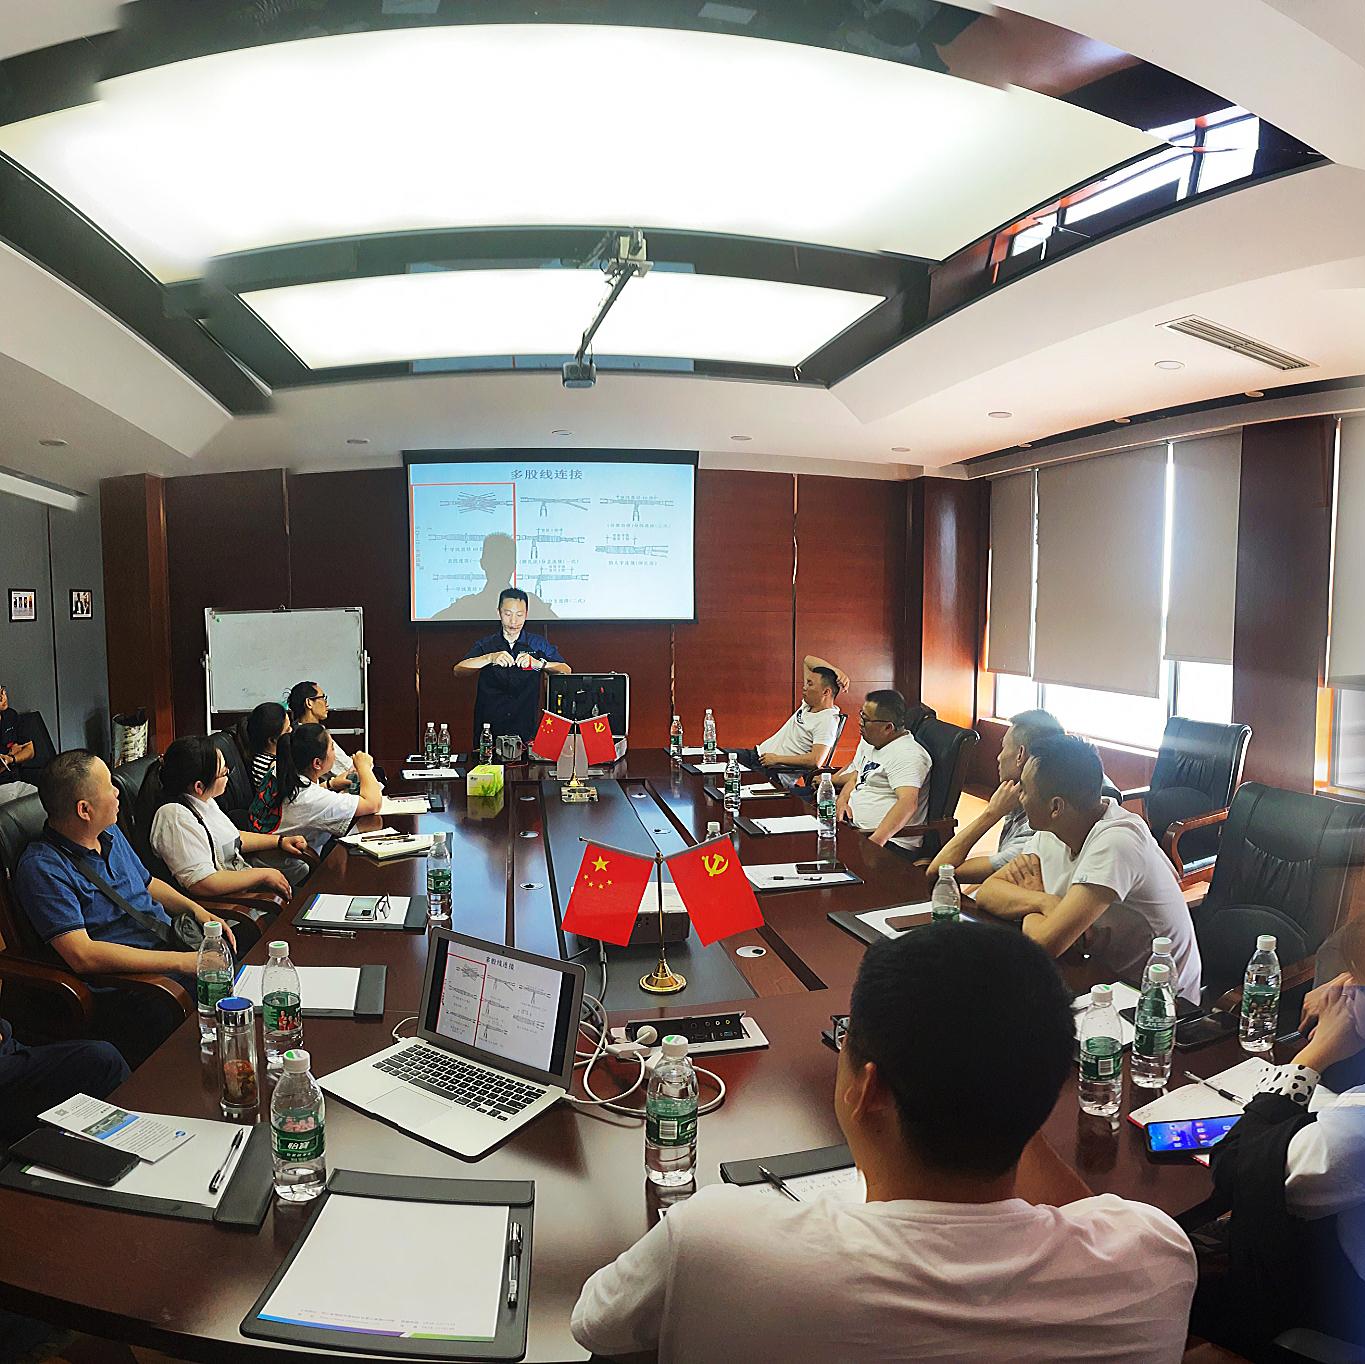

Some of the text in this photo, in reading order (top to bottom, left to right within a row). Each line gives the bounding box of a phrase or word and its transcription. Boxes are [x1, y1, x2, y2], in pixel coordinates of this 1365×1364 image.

[511, 469, 583, 480] 多股线连接
